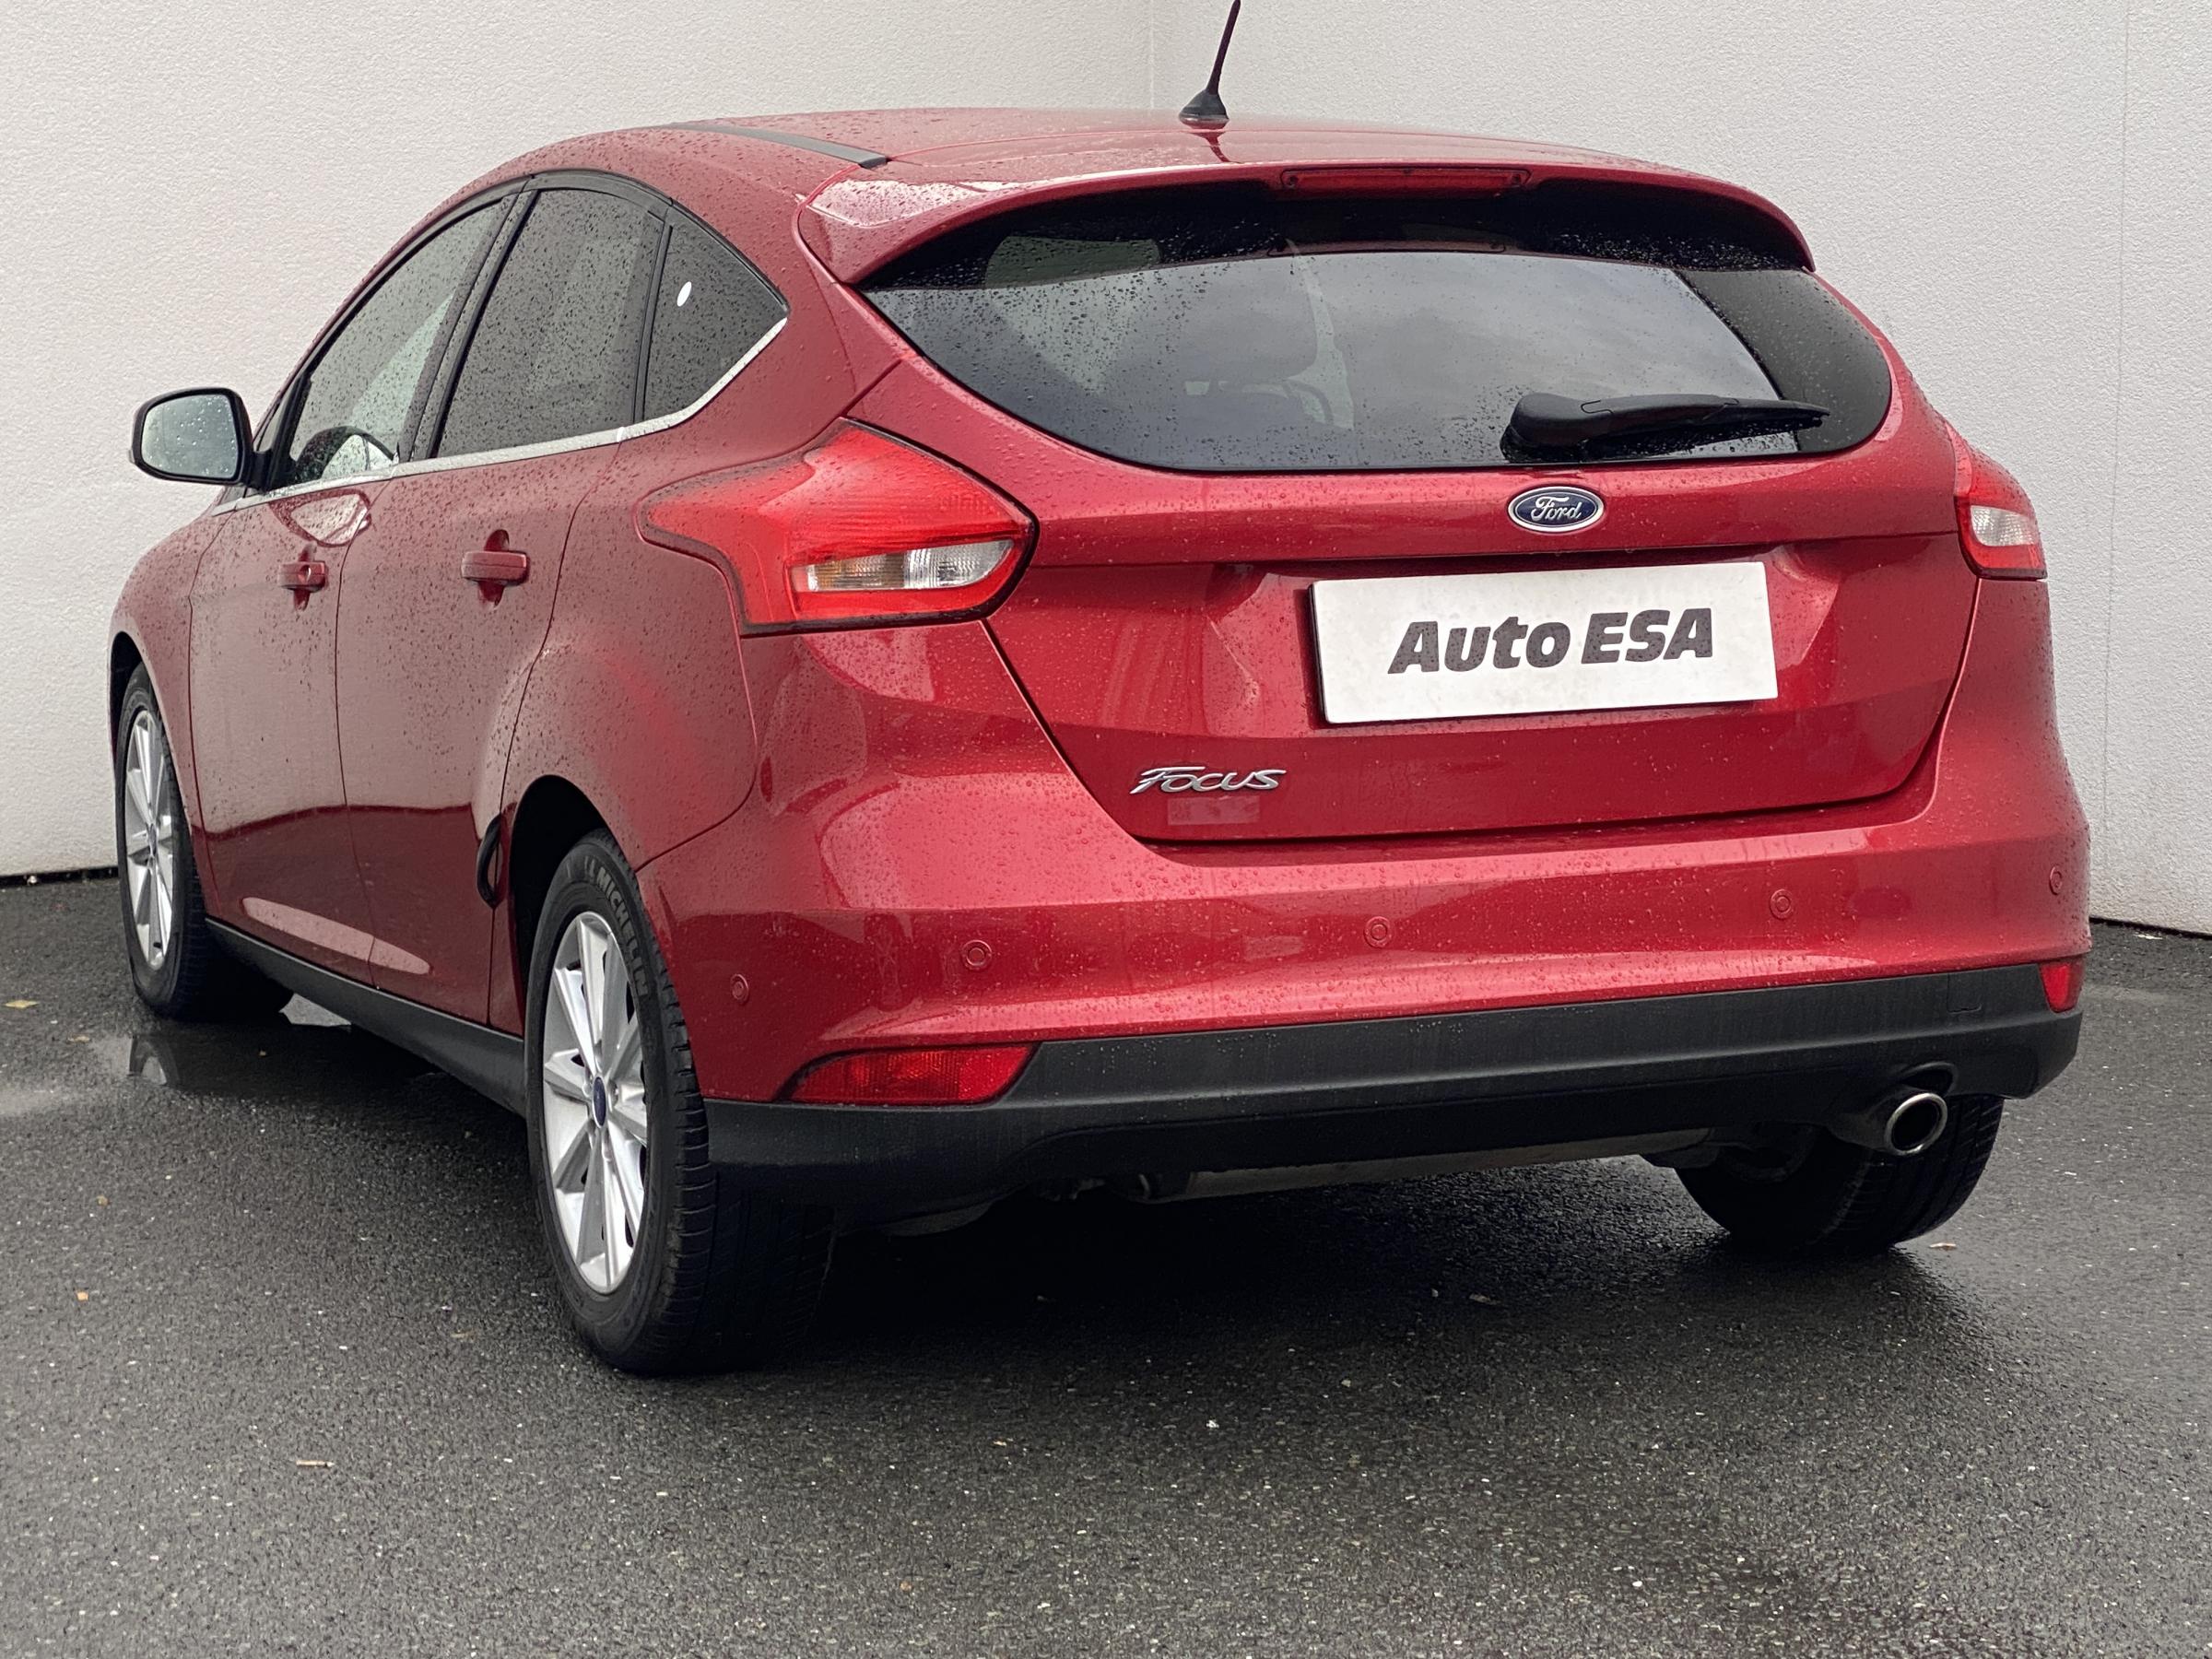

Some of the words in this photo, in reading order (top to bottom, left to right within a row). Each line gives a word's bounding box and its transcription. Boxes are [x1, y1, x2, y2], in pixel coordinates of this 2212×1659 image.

[1531, 496, 1583, 521] Ford
[1387, 616, 1571, 674] Auto
[1581, 607, 1713, 664] ESA
